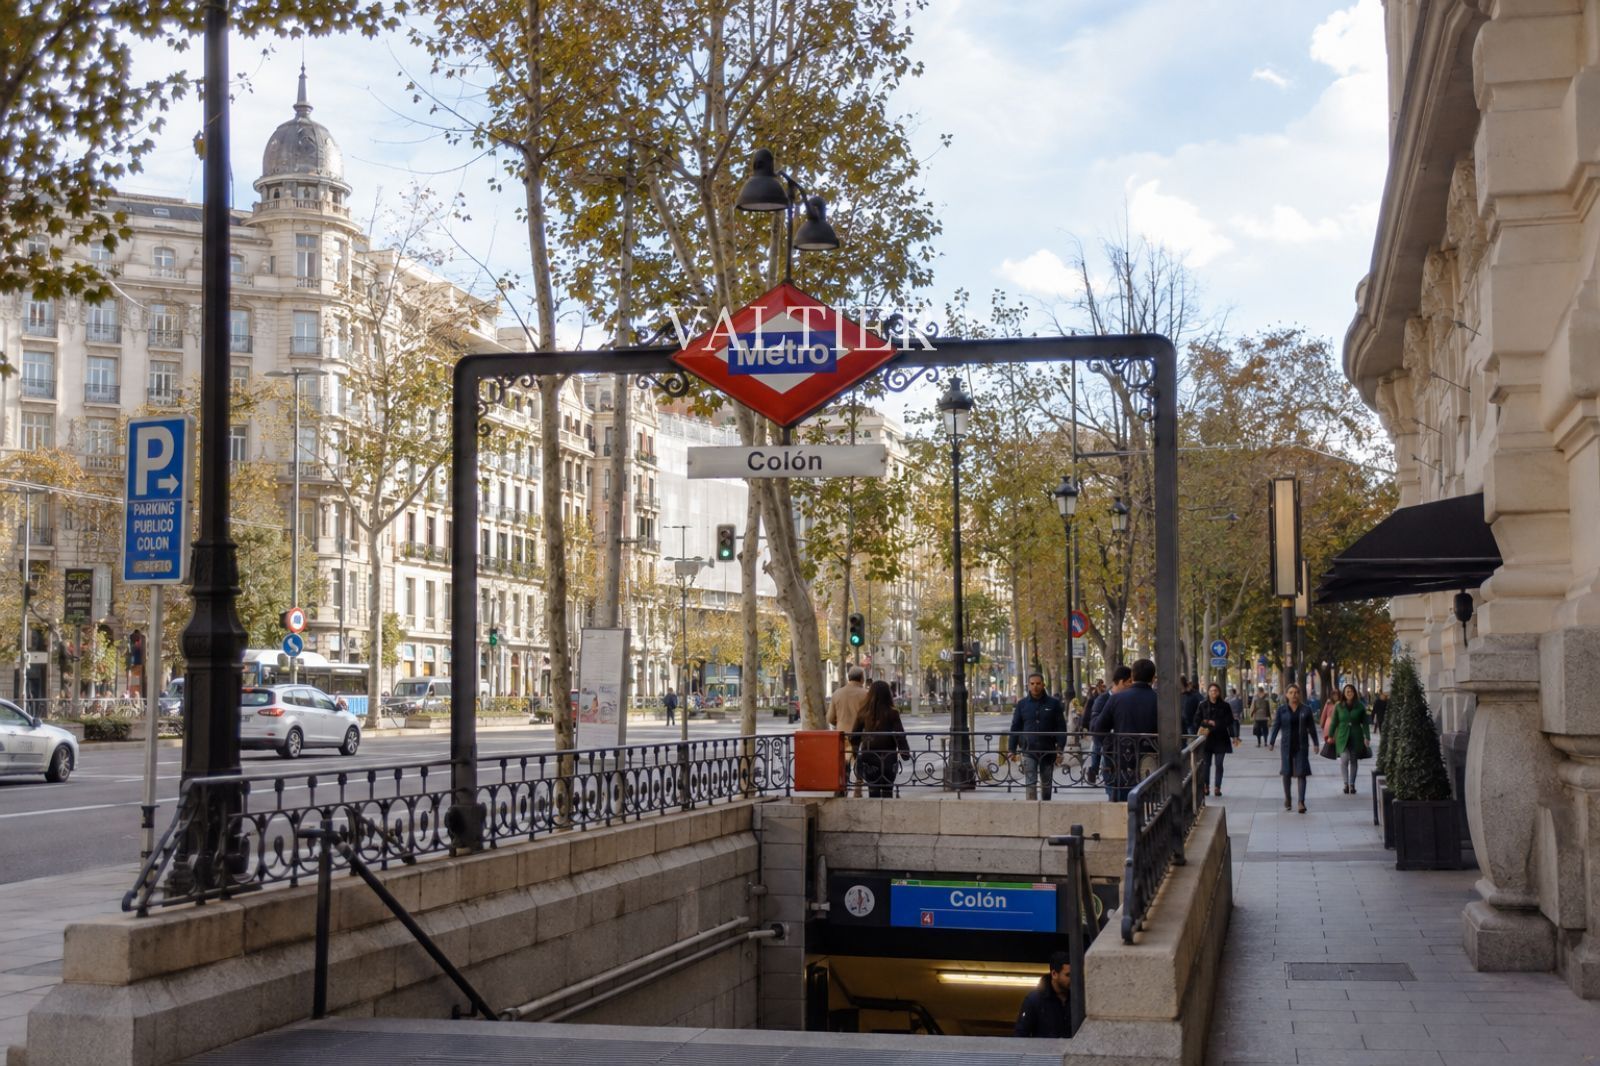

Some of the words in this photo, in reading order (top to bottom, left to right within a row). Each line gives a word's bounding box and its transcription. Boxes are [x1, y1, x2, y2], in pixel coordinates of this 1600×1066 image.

[737, 340, 829, 366] Metro
[136, 426, 174, 496] P
[747, 451, 822, 471] Colón
[134, 501, 175, 516] PARKING
[134, 519, 173, 533] PUBLICO
[137, 536, 169, 551] COLON
[950, 891, 1006, 908] Colón
[923, 913, 932, 924] 4
